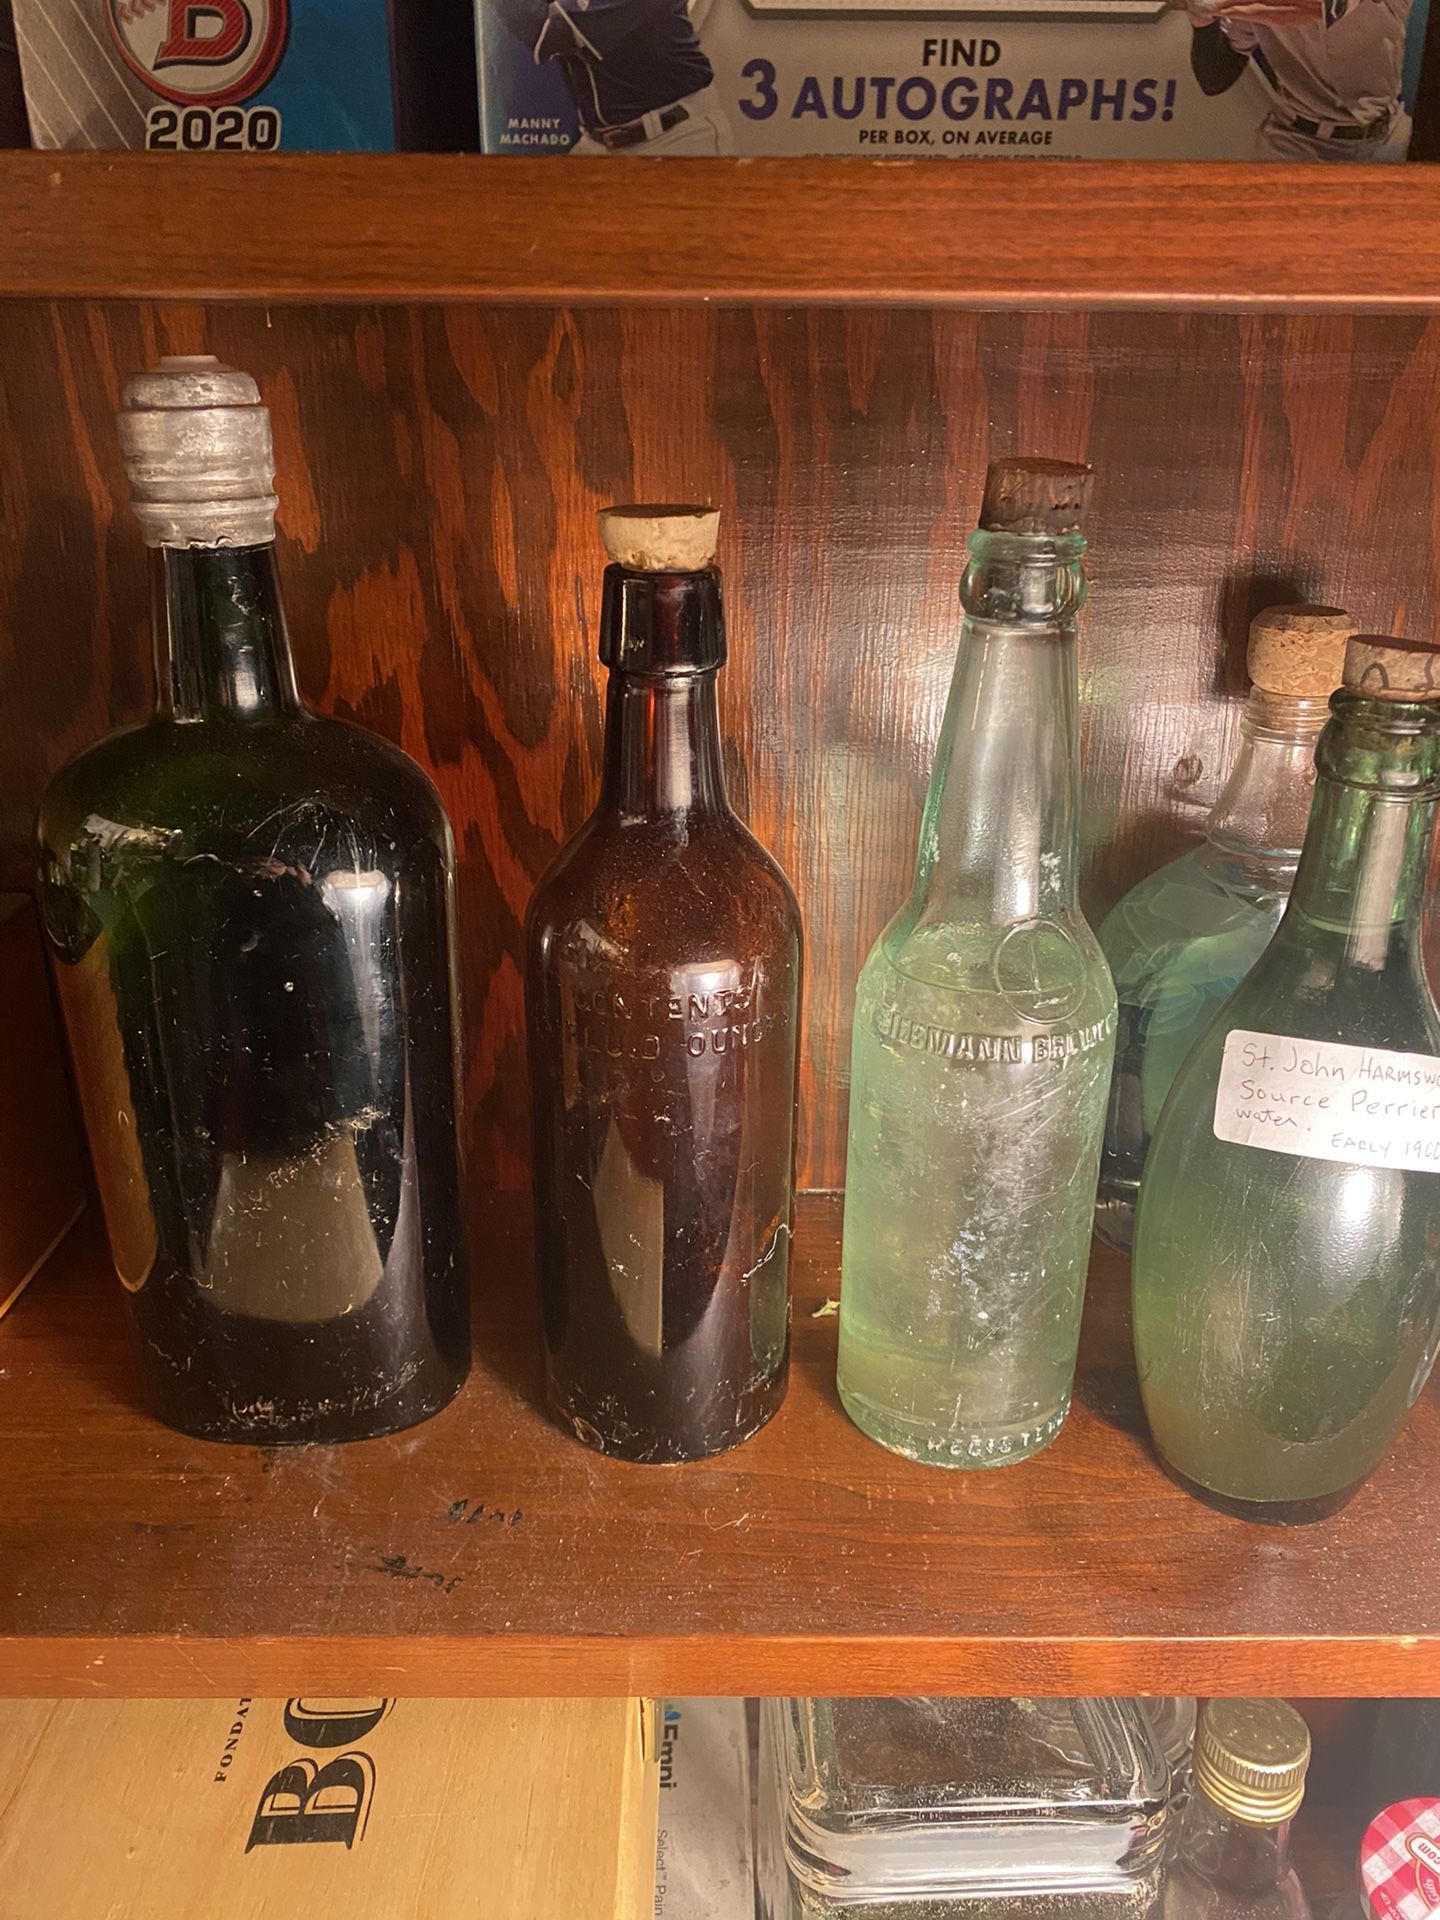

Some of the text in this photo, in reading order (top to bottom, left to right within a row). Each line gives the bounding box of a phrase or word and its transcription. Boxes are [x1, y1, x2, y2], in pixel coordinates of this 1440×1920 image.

[921, 38, 1001, 67] FIND
[738, 58, 1177, 122] 3 AUTOGRAPHS!
[148, 108, 279, 150] 2020
[507, 117, 561, 129] MANNY
[499, 133, 570, 145] MACHADO
[859, 130, 1053, 147] PER BOX, ON AVERAGE
[1241, 1042, 1274, 1071] St.
[1282, 1045, 1345, 1081] John
[1239, 1079, 1440, 1119] Source Perrier
[1331, 1131, 1391, 1159] EARLY
[655, 1884, 667, 1916] Pain
